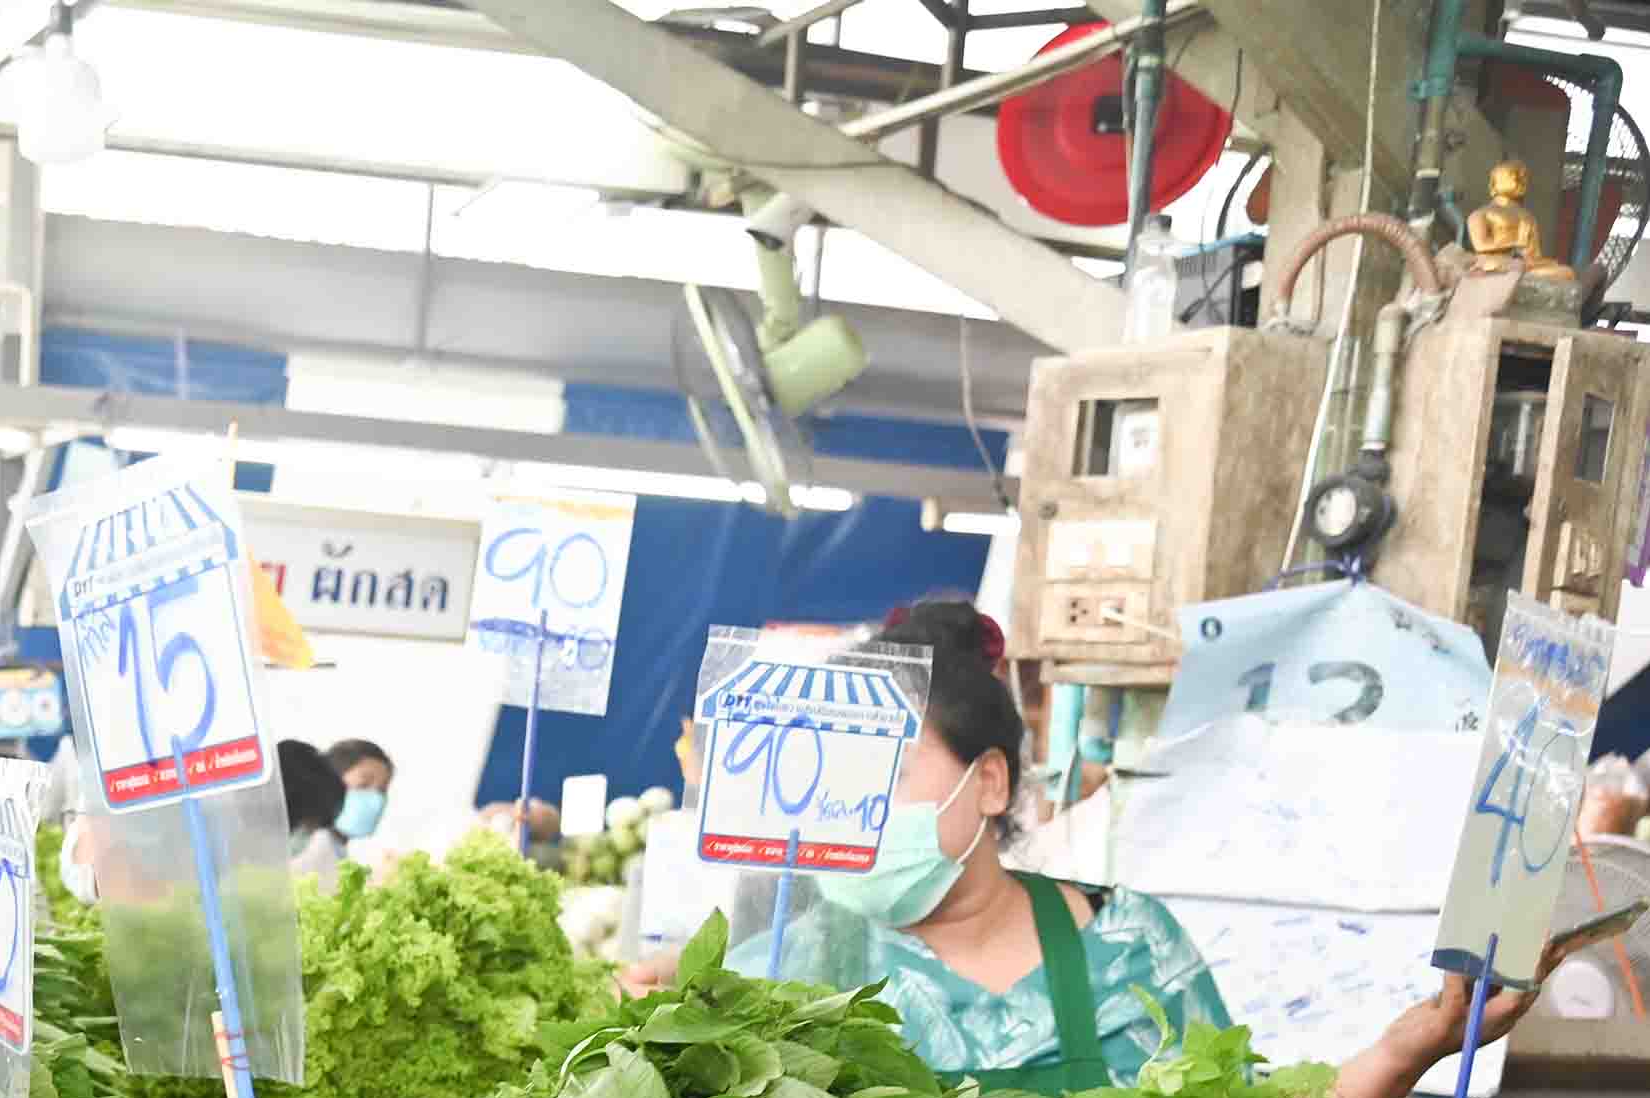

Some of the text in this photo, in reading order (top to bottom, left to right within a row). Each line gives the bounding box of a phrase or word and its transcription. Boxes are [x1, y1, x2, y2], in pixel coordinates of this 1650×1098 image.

[311, 540, 449, 612] ผักสด
[484, 527, 608, 609] 90
[117, 575, 218, 765] 15
[723, 714, 823, 816] 90
